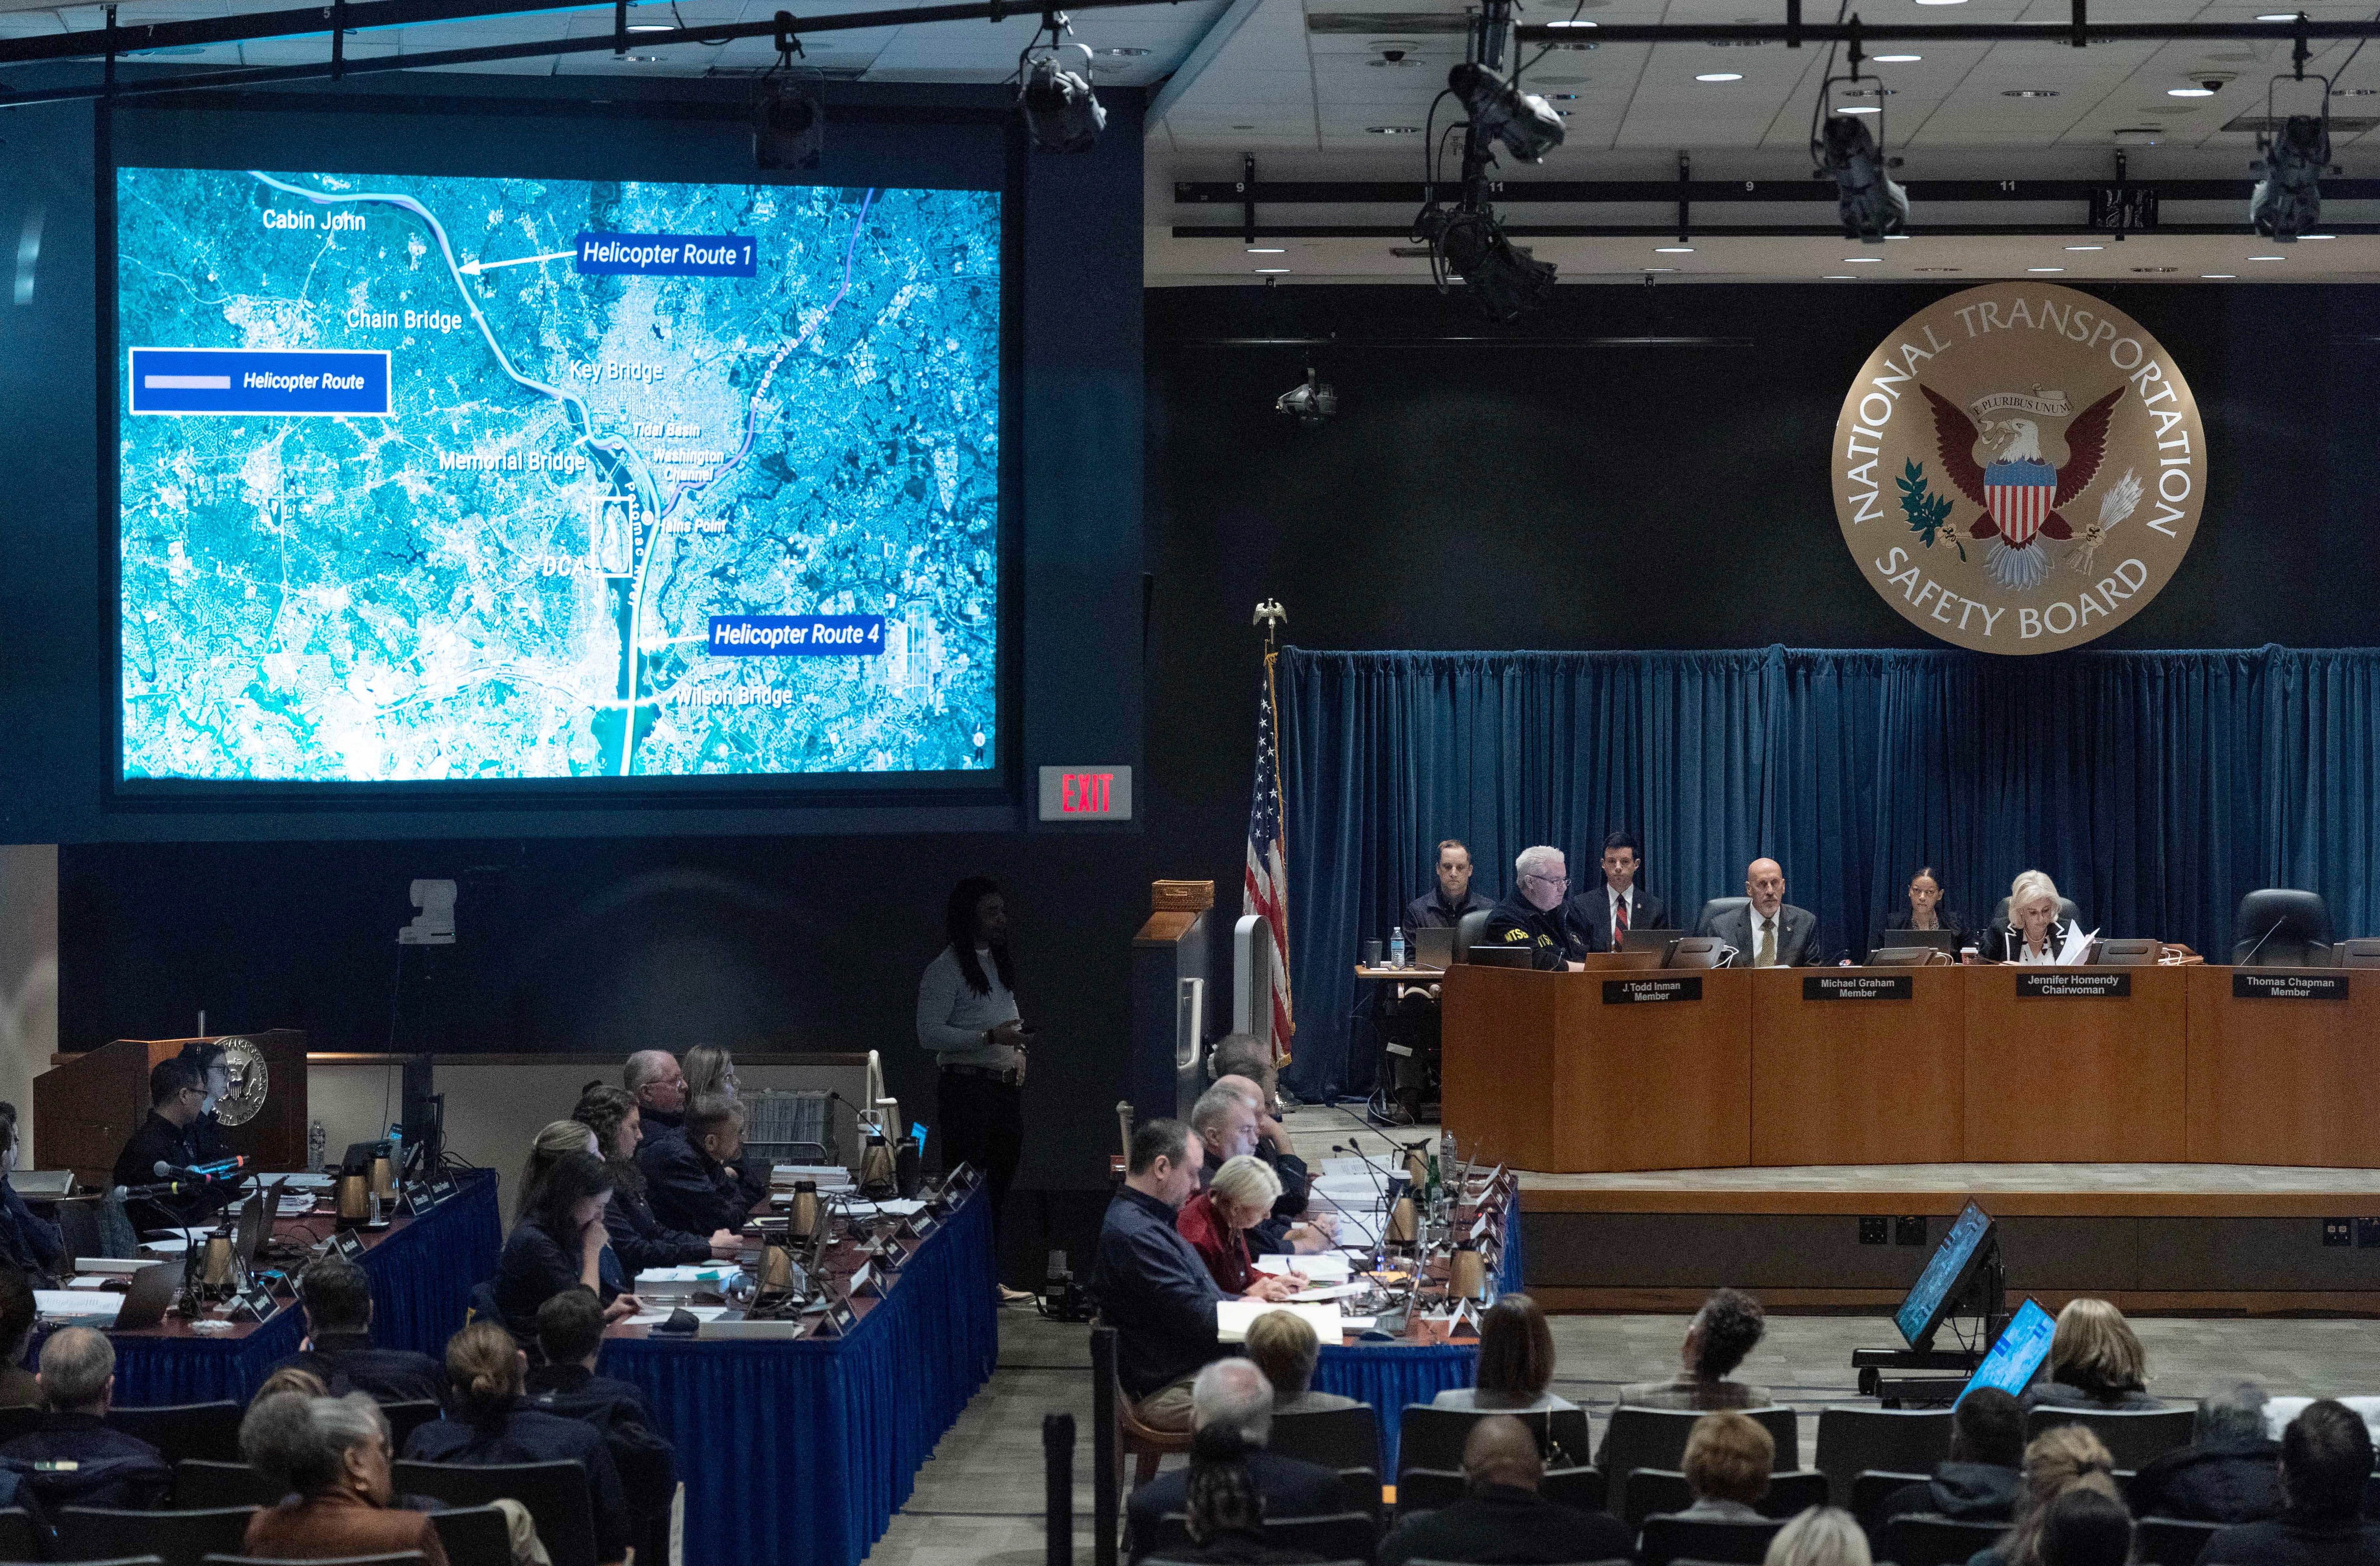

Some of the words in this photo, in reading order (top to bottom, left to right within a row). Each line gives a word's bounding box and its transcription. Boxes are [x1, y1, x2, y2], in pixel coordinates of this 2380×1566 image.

[1236, 182, 1244, 192] 9
[1746, 181, 1754, 191] 9
[2000, 180, 2014, 191] 11
[262, 209, 315, 230] Cabin
[320, 210, 366, 231] John
[583, 240, 679, 268] Helicopter
[683, 244, 736, 266] Route
[742, 245, 751, 264] 1
[347, 310, 398, 330] Chain
[405, 309, 462, 333] Bridge
[569, 359, 602, 383] Key
[607, 361, 664, 383] Bridge
[244, 371, 319, 392] Helicopter
[322, 372, 364, 390] Route
[1982, 396, 2032, 410] PLURIBUS
[2035, 402, 2071, 413] UNUM
[1848, 324, 1951, 525] NATIONAL
[1954, 298, 2191, 538] TRANSPORTATION
[632, 422, 664, 438] Tidal
[666, 423, 701, 438] Basin
[439, 450, 522, 471] Memorial
[528, 451, 586, 474] Bridge
[654, 448, 725, 465] Washington
[664, 467, 714, 482] Channel
[695, 519, 726, 533] Point
[543, 556, 586, 577] DCA
[1875, 547, 2005, 636] SAFETY
[2020, 558, 2147, 638] BOARD
[714, 623, 808, 649] Helicopter
[812, 624, 863, 644] Route
[867, 623, 879, 642] 4
[675, 687, 731, 705] Wilson
[737, 687, 792, 708] Bridge
[1062, 774, 1113, 813] EXIT
[1504, 928, 1529, 942] NTSB
[1623, 983, 1629, 992] J.
[1631, 982, 1652, 992] Todd
[1654, 982, 1681, 991] Inman
[1821, 979, 1856, 988] Michael
[1859, 979, 1895, 987] Graham
[2028, 975, 2068, 984] Jennifer
[2071, 976, 2118, 986] Homendy
[2246, 977, 2285, 986] Thomas
[2288, 978, 2334, 988] Chapman
[1635, 992, 1670, 1001] Member
[1839, 989, 1876, 997] Member
[2042, 985, 2105, 994] Chairwoman
[2271, 987, 2311, 997] Member
